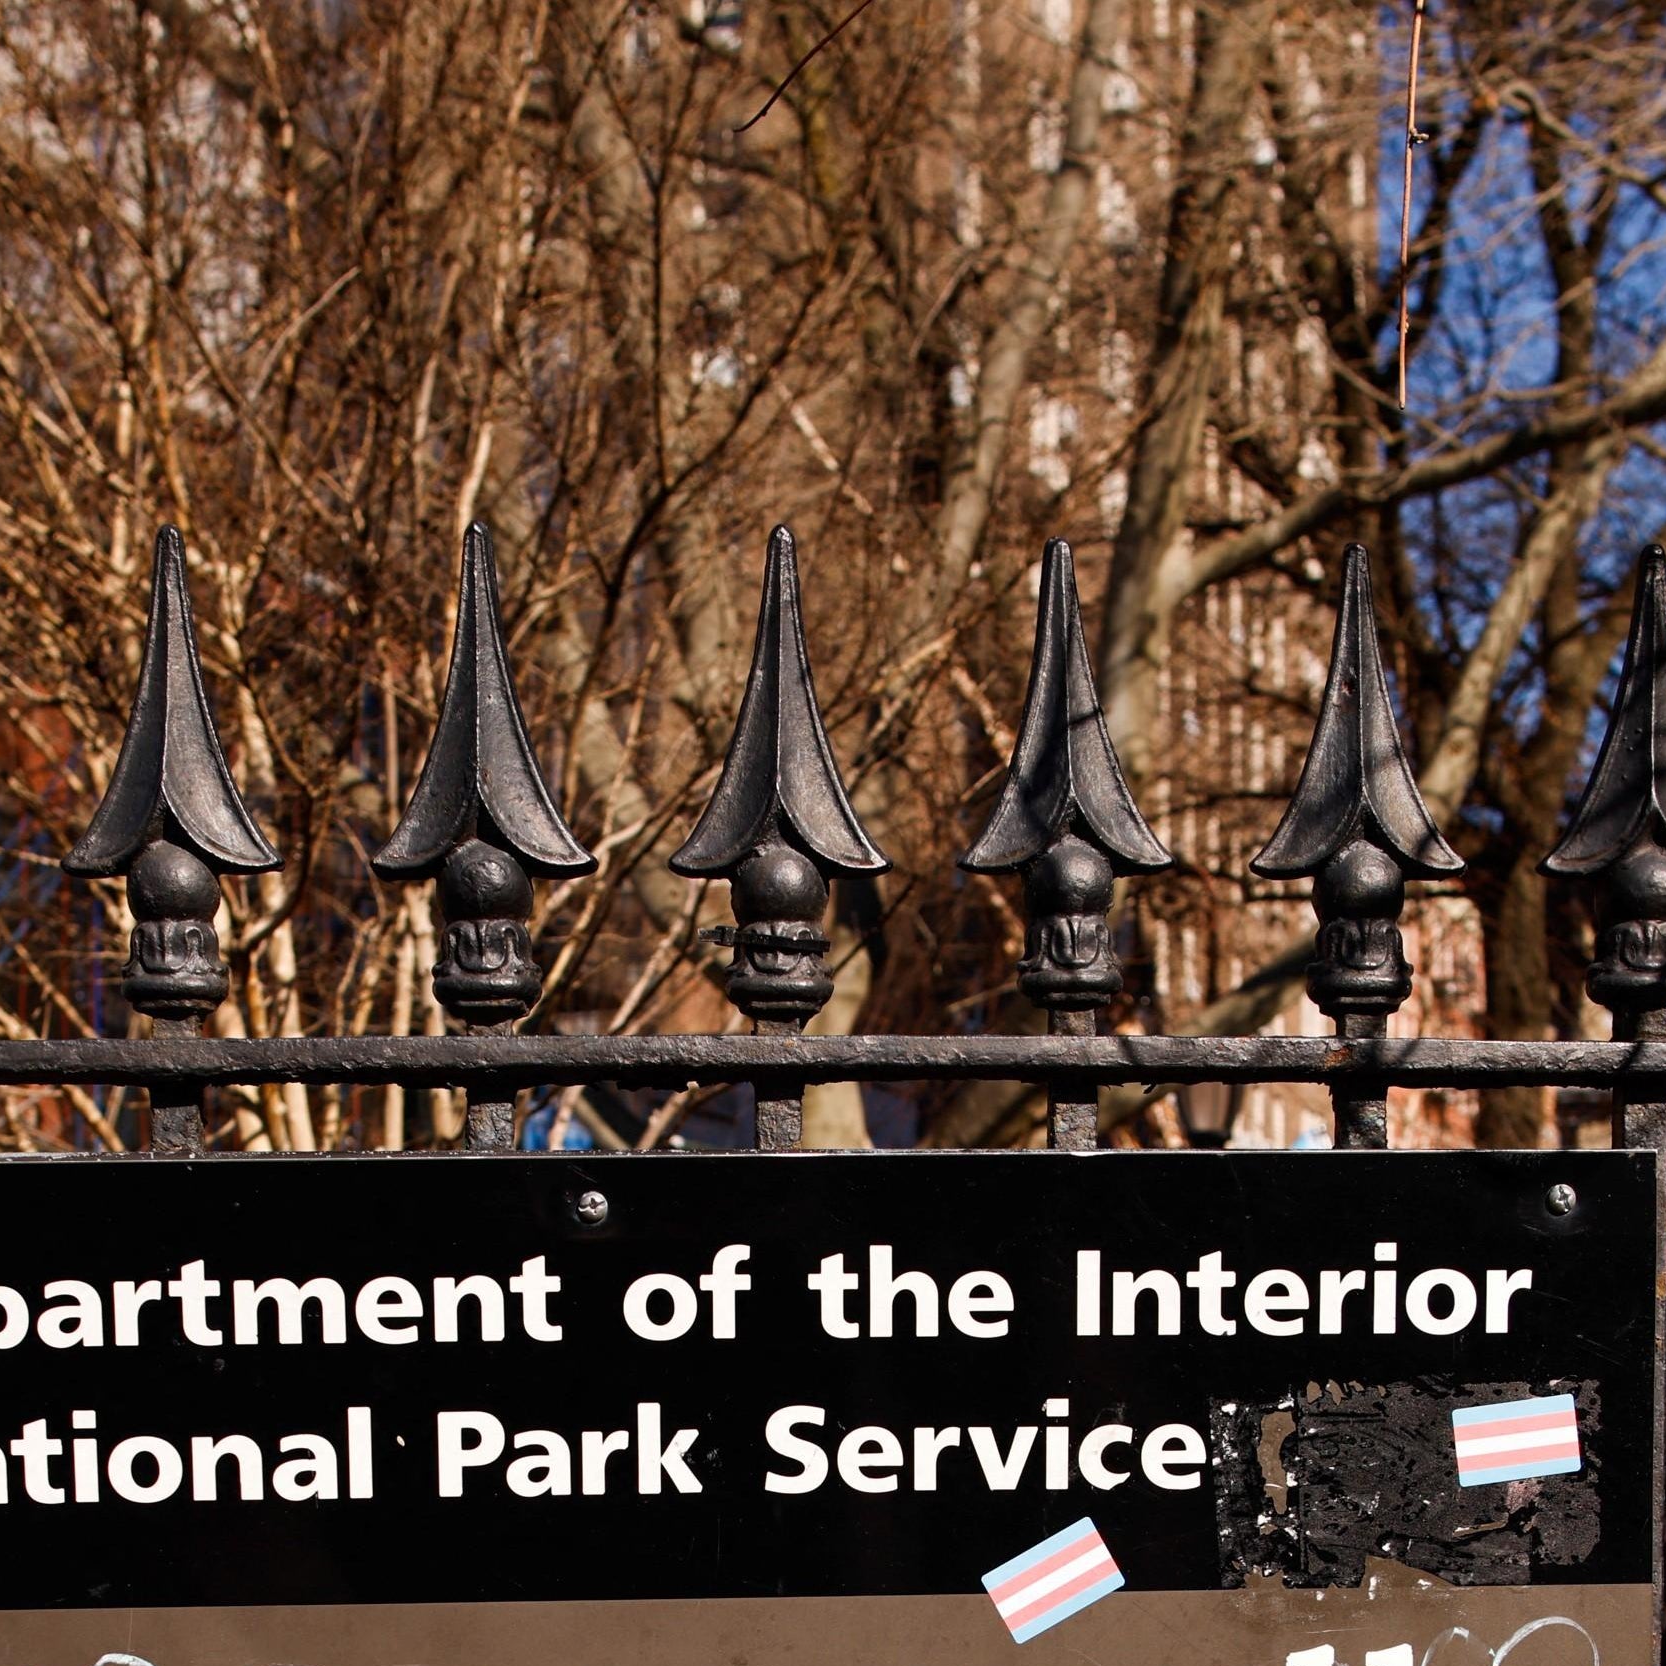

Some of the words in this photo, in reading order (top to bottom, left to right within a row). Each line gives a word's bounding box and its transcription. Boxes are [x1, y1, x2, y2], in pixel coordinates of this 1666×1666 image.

[623, 1244, 752, 1341] of
[807, 1244, 1016, 1339] the
[1076, 1242, 1533, 1337] Interior
[437, 1402, 703, 1498] Park
[764, 1398, 1207, 1494] Service
